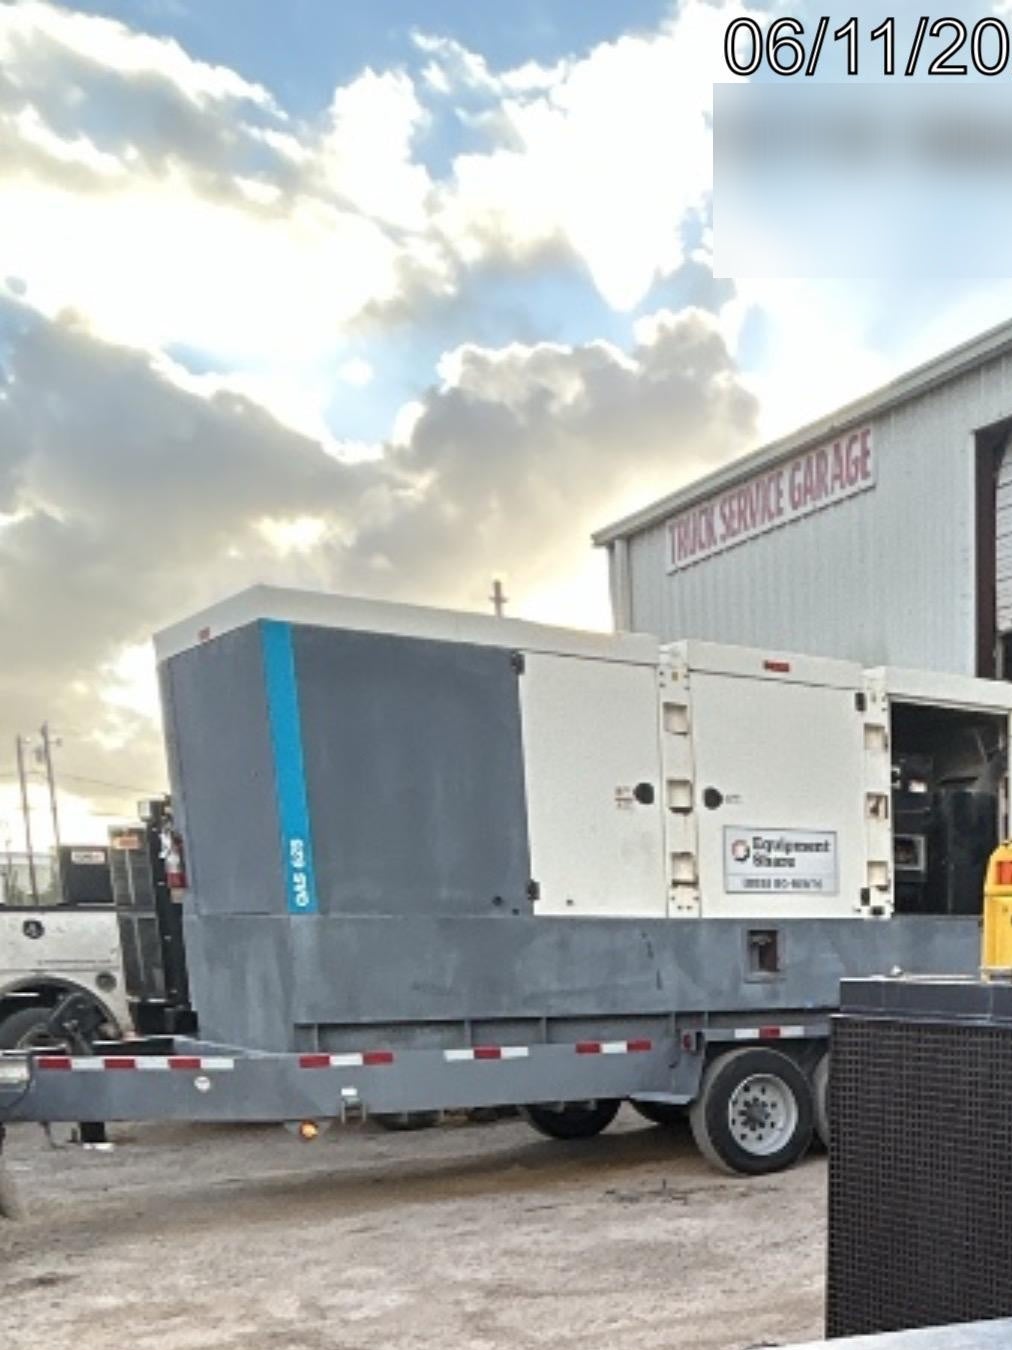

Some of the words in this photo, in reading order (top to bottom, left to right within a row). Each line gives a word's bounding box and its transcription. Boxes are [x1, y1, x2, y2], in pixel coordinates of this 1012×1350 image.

[669, 503, 717, 566] TRUCK
[719, 469, 785, 542] SERVICE
[788, 428, 871, 511] GARAGE
[752, 836, 830, 855] Equipment
